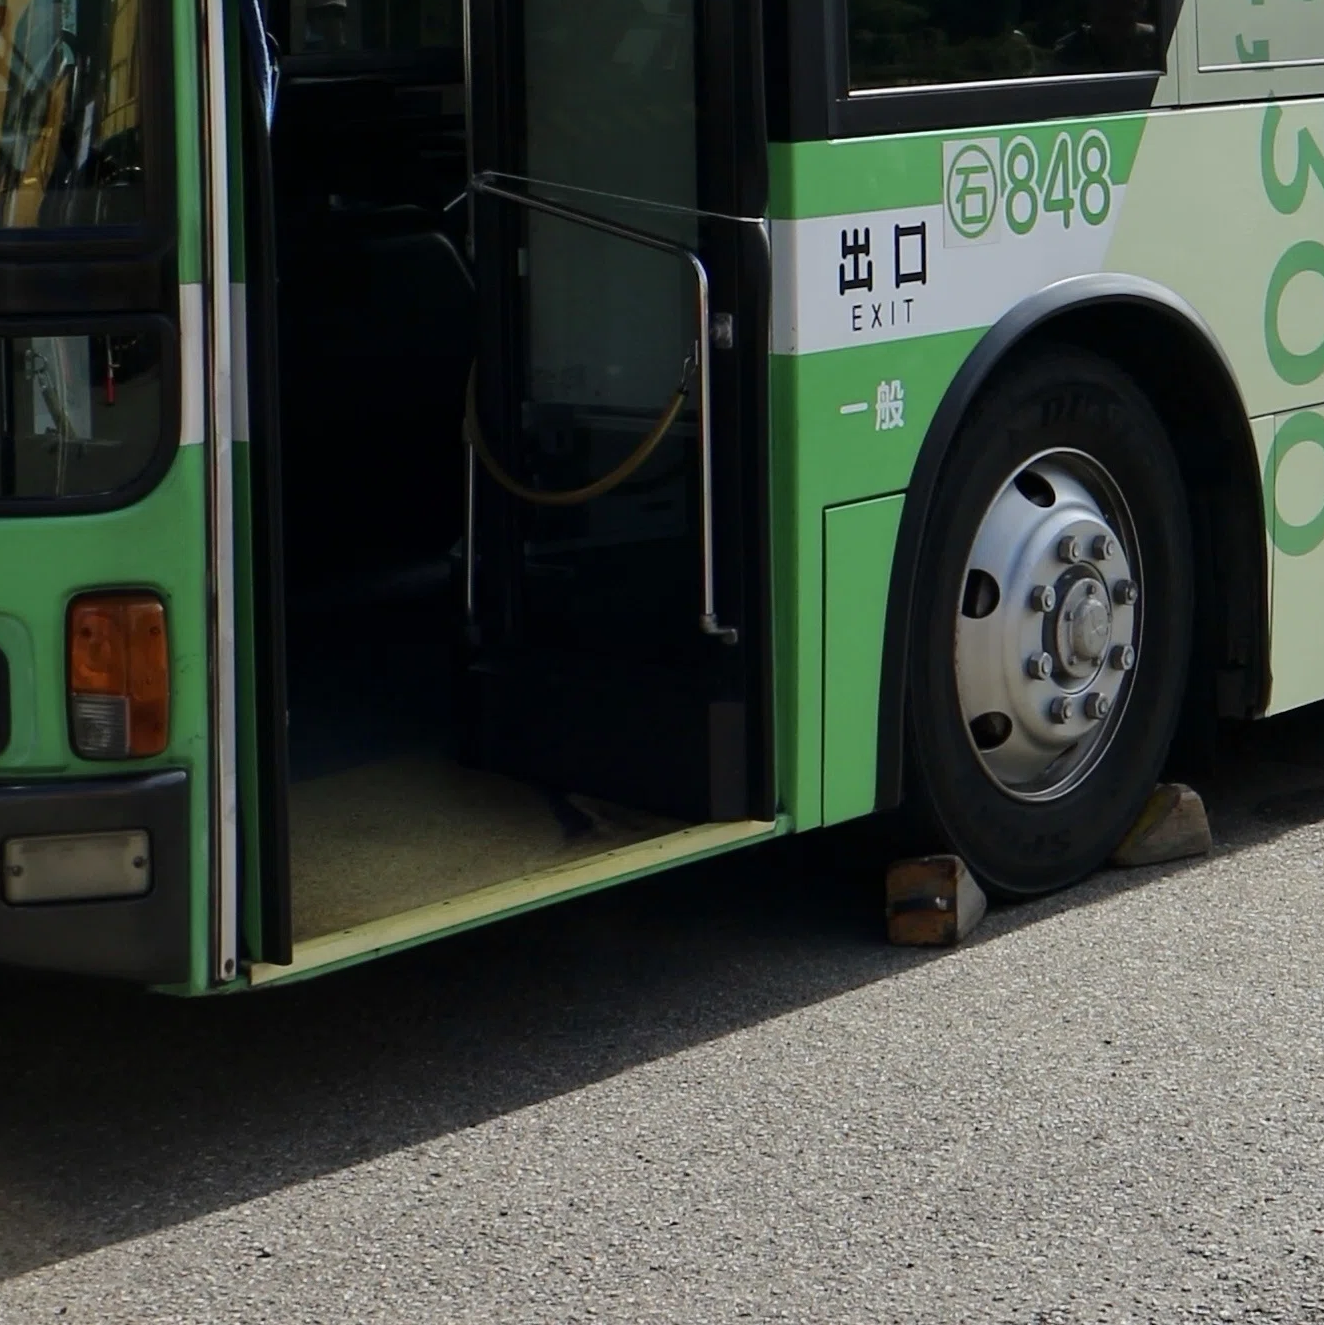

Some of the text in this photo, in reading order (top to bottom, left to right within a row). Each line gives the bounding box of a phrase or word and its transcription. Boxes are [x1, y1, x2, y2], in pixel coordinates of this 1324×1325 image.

[1004, 130, 1111, 235] 848
[839, 220, 927, 296] 出口
[852, 298, 914, 332] EXIT
[840, 379, 905, 432] 一般
